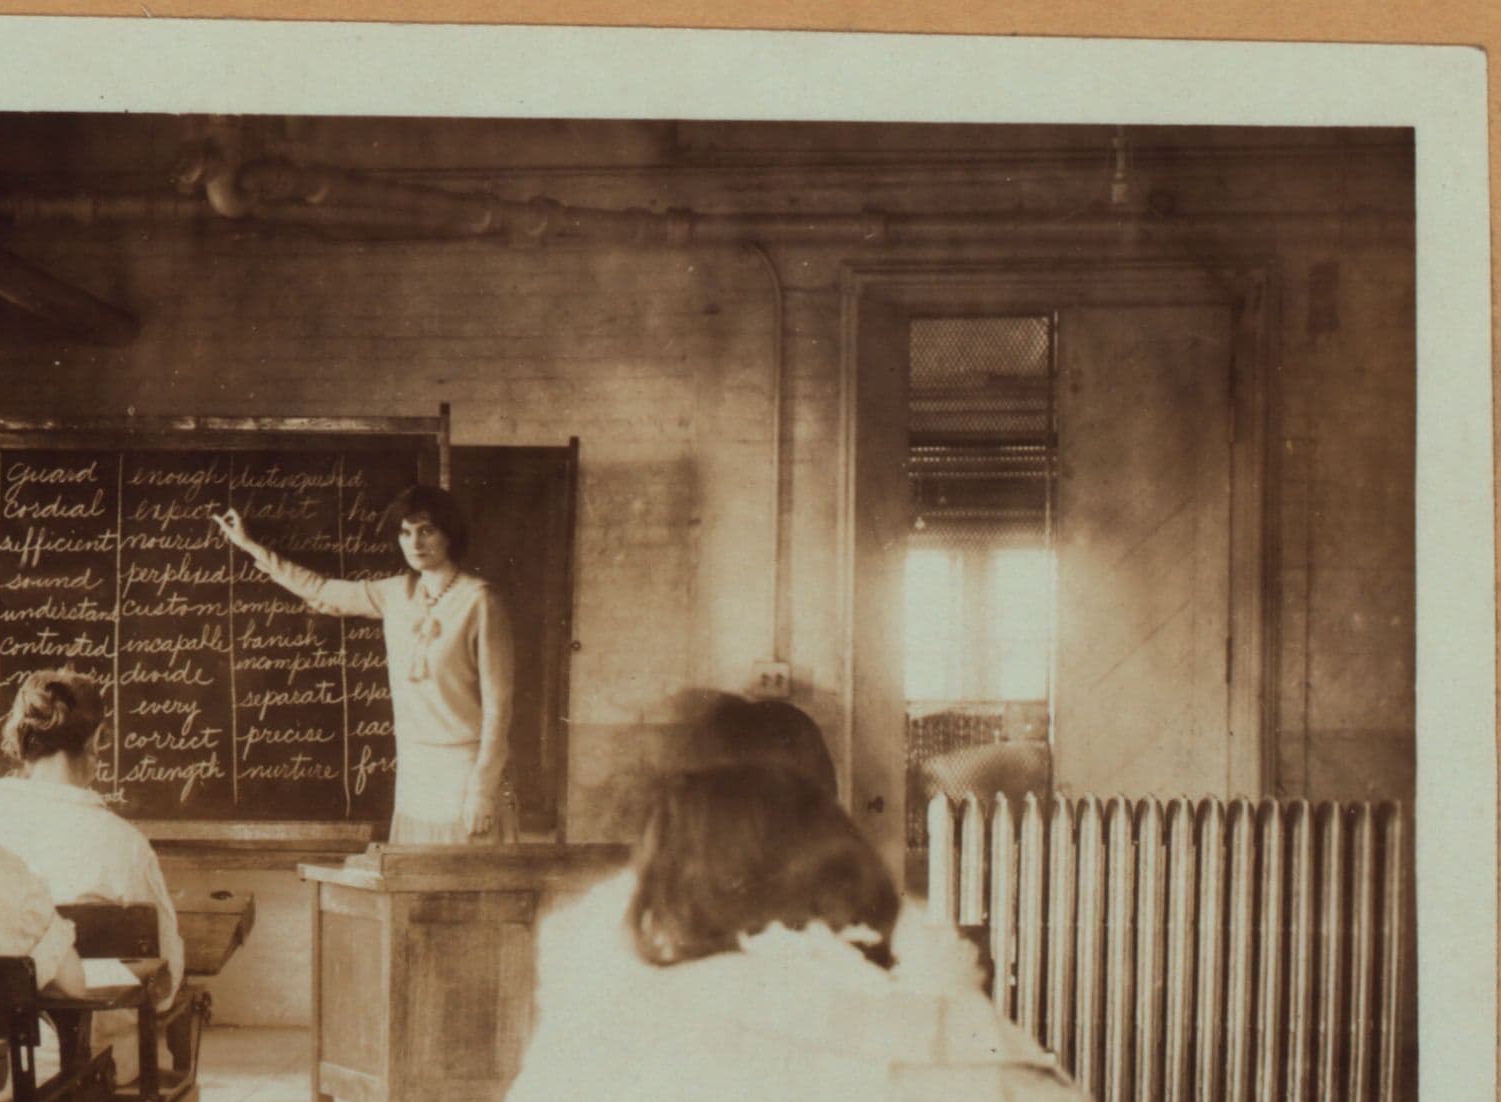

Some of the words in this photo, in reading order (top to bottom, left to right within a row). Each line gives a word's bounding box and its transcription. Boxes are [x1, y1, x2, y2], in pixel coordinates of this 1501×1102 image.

[5, 461, 98, 501] guard
[0, 527, 119, 567] sufficient
[121, 523, 225, 551] nourish
[1, 567, 105, 591] sound
[122, 592, 230, 617] custom
[0, 628, 117, 657] contented
[120, 624, 231, 667] incapable
[237, 619, 326, 650] banish
[120, 661, 214, 686] divide
[239, 682, 343, 721] separate
[130, 700, 202, 736] every
[124, 728, 222, 750] correct
[237, 727, 335, 761] precise
[124, 751, 225, 803] strength
[238, 753, 339, 779] nurture
